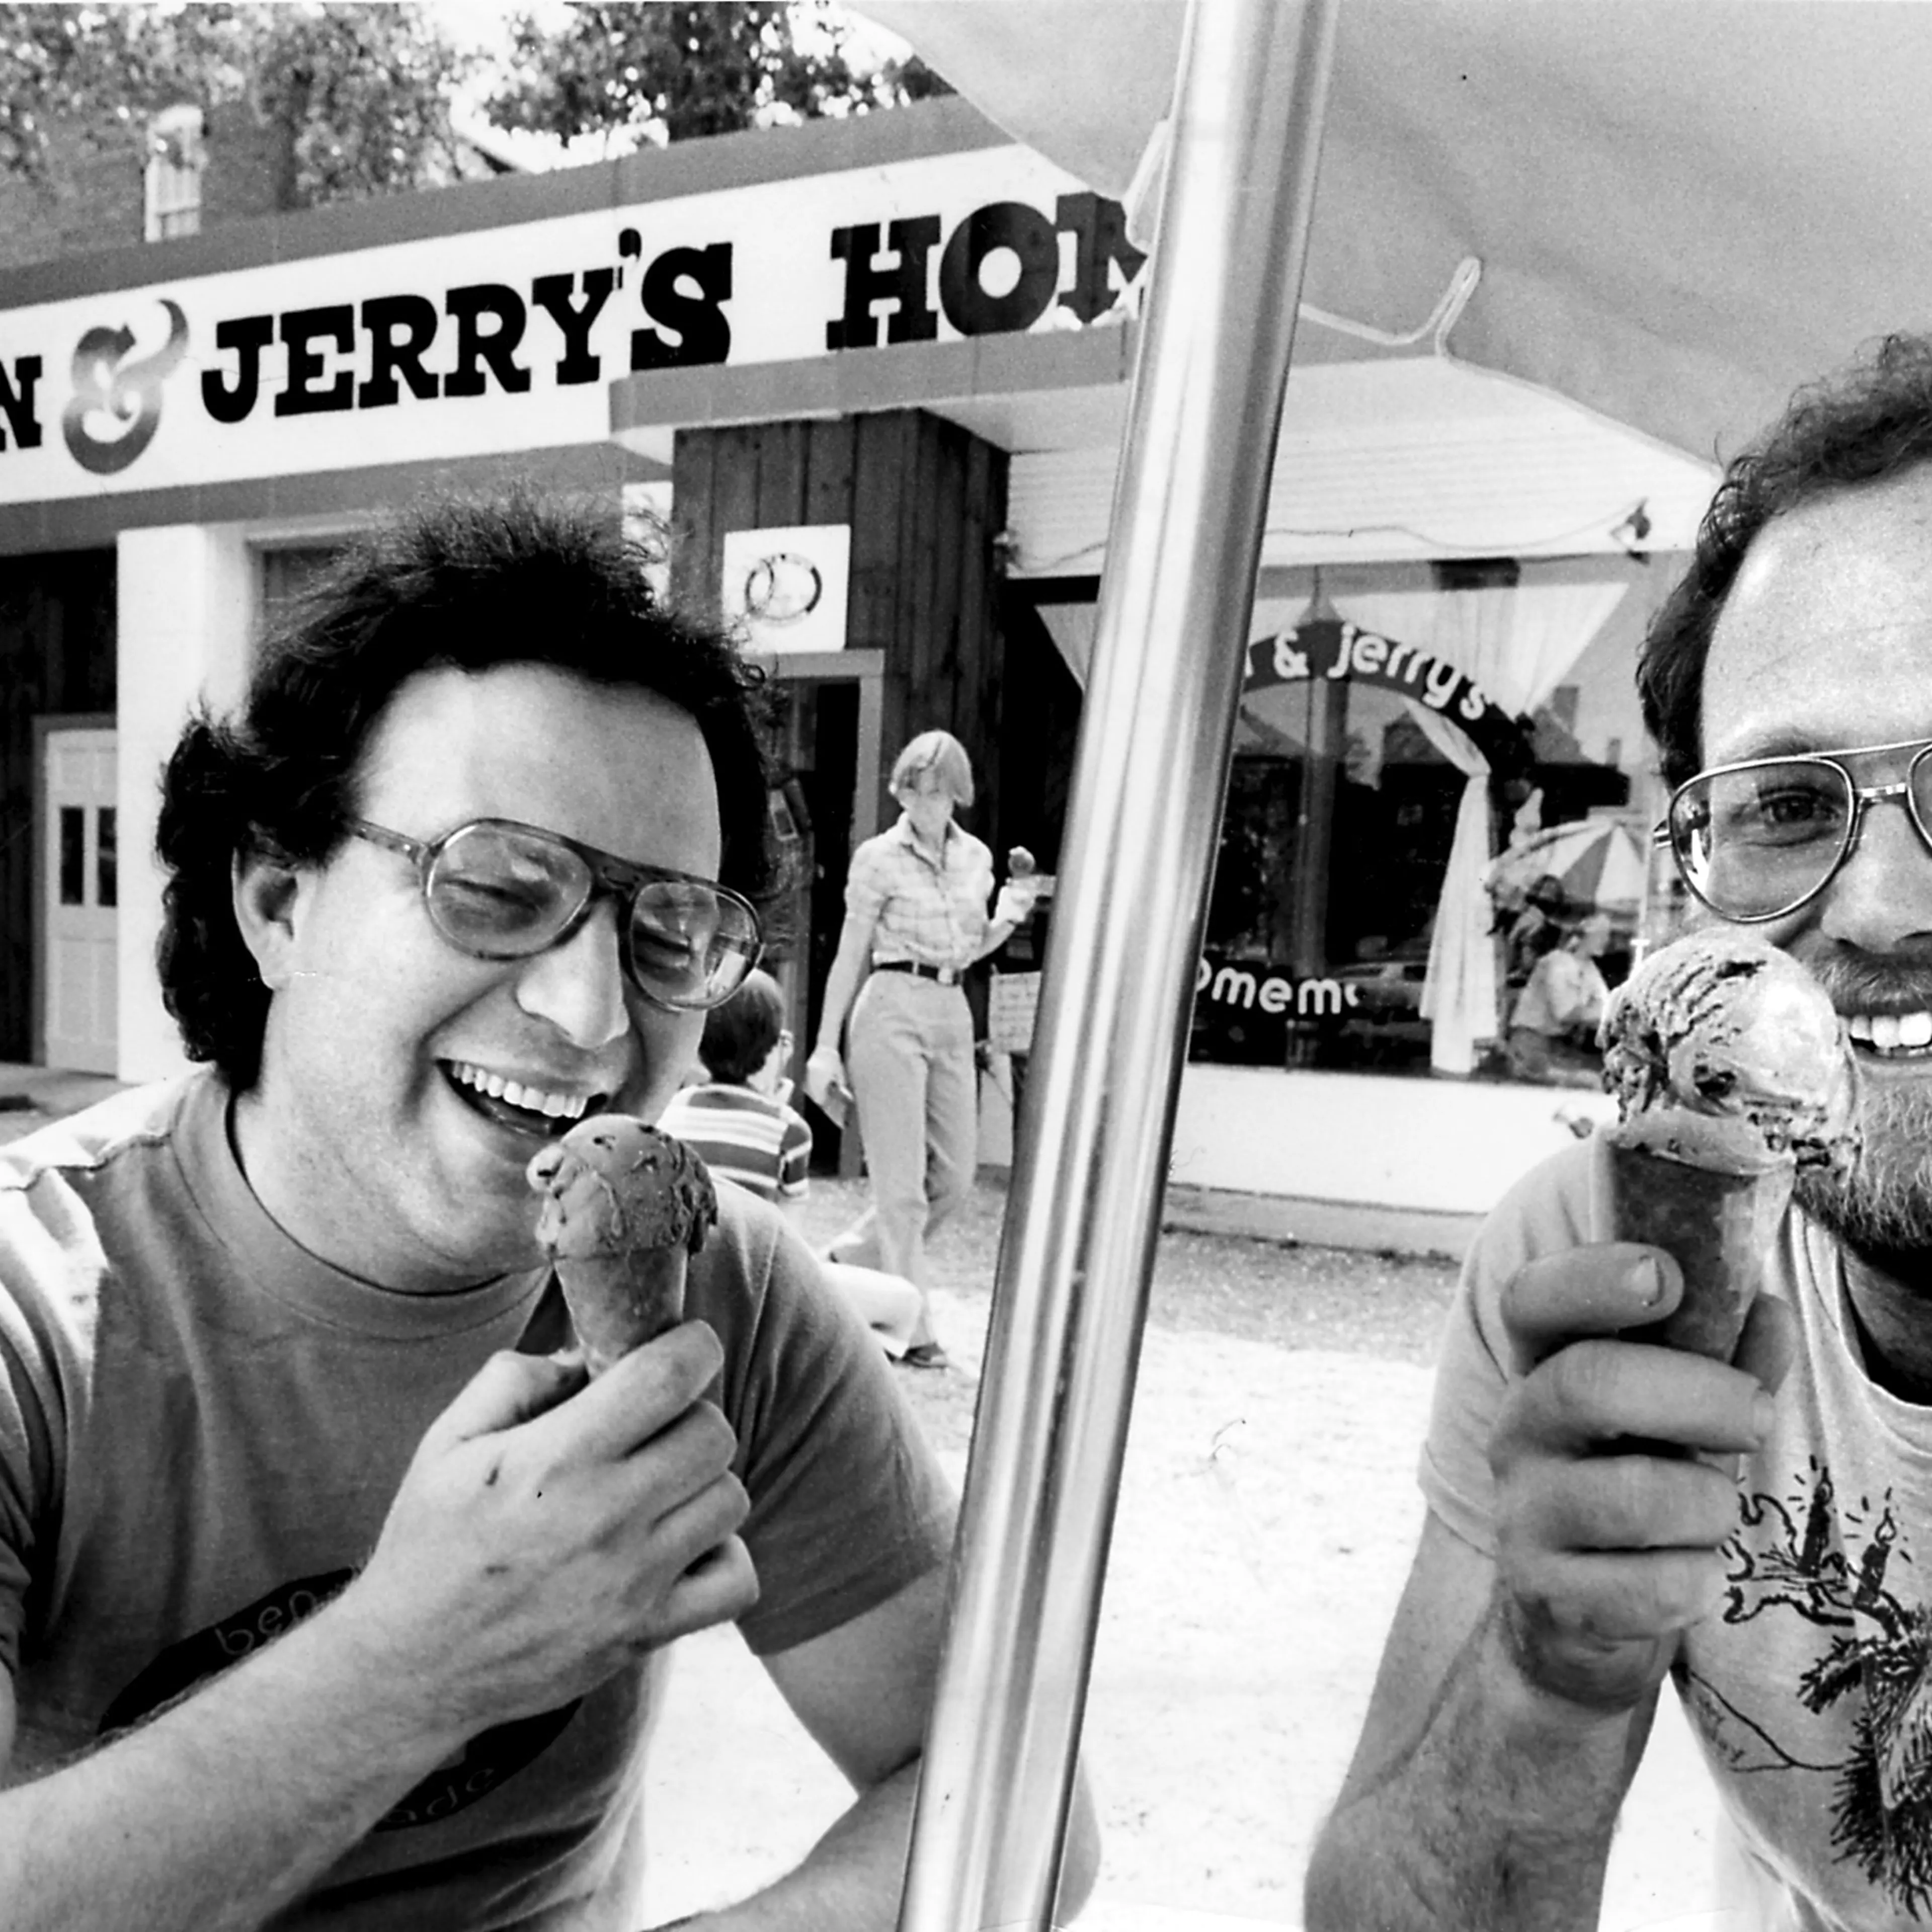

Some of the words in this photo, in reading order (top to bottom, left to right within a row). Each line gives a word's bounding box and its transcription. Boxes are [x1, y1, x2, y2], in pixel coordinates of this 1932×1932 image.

[61, 300, 190, 475] &
[201, 228, 733, 423] JERRY'S
[1273, 630, 1310, 679] &
[1327, 622, 1486, 720] jerry's
